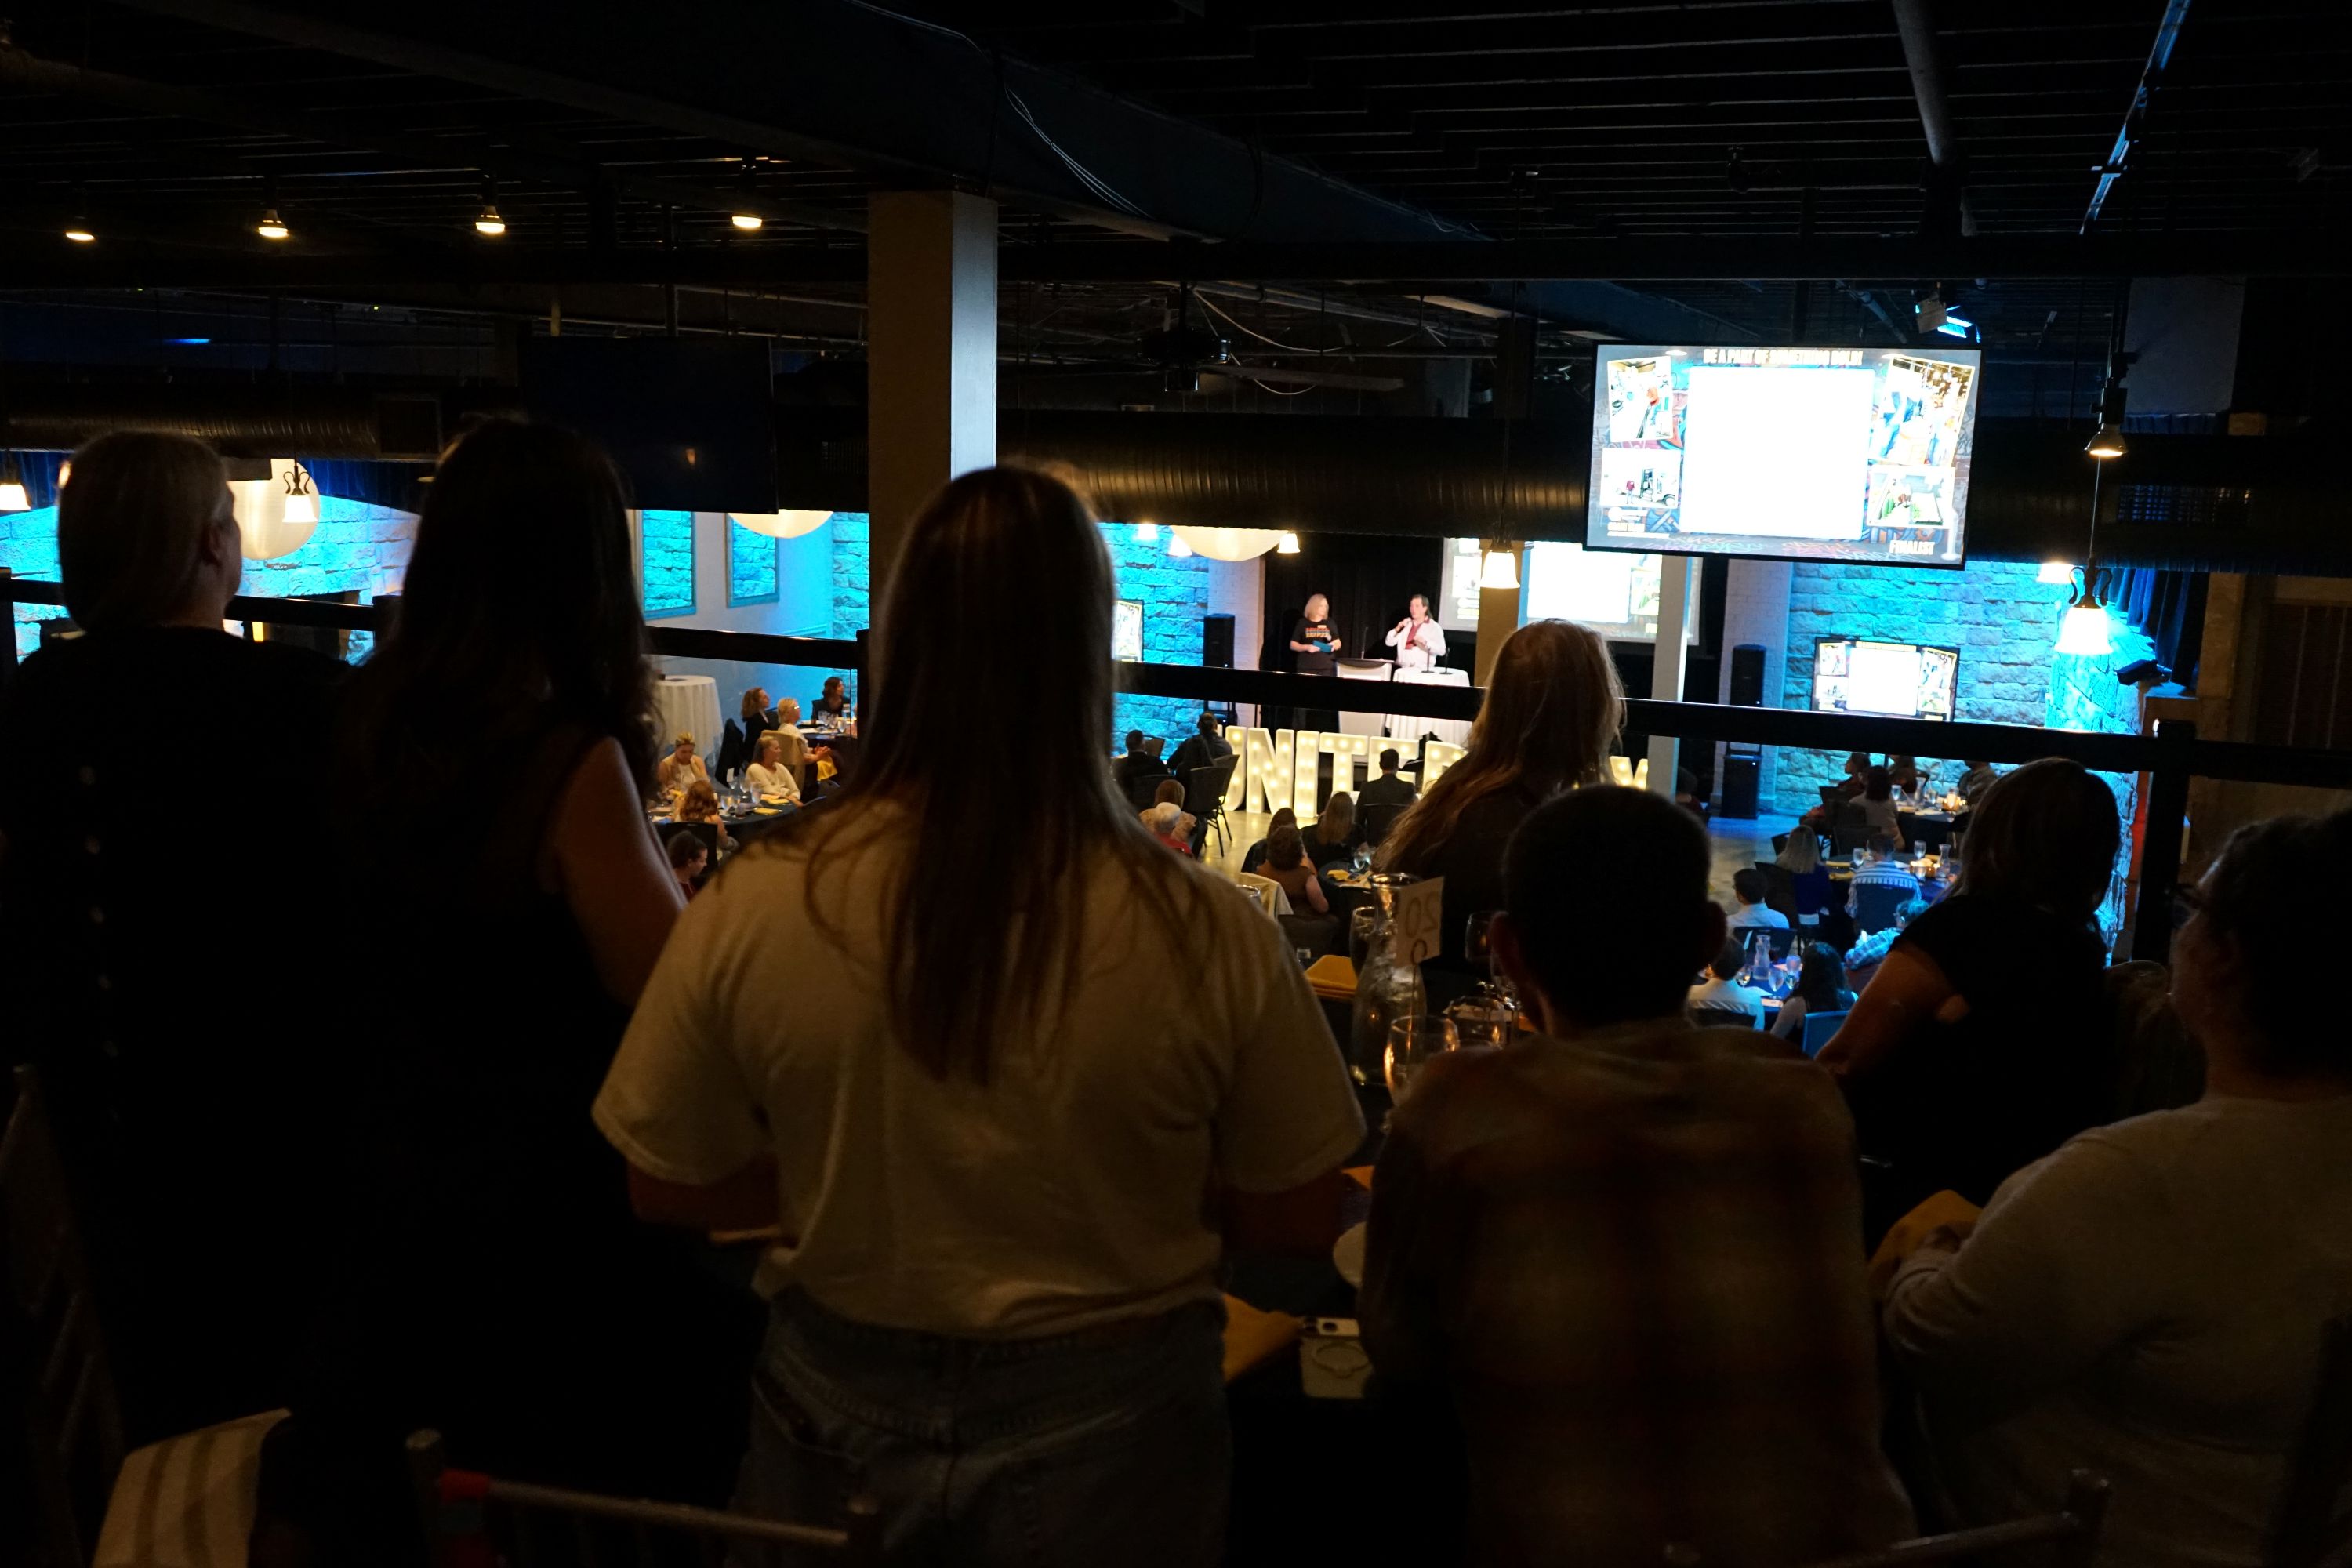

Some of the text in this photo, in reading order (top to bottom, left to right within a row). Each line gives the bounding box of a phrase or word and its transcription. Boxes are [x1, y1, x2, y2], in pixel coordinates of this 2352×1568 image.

[1704, 349, 1718, 364] BE
[1718, 349, 1726, 364] A
[1726, 349, 1754, 365] PART
[1755, 350, 1769, 365] OF
[1889, 539, 1936, 556] FINALIST
